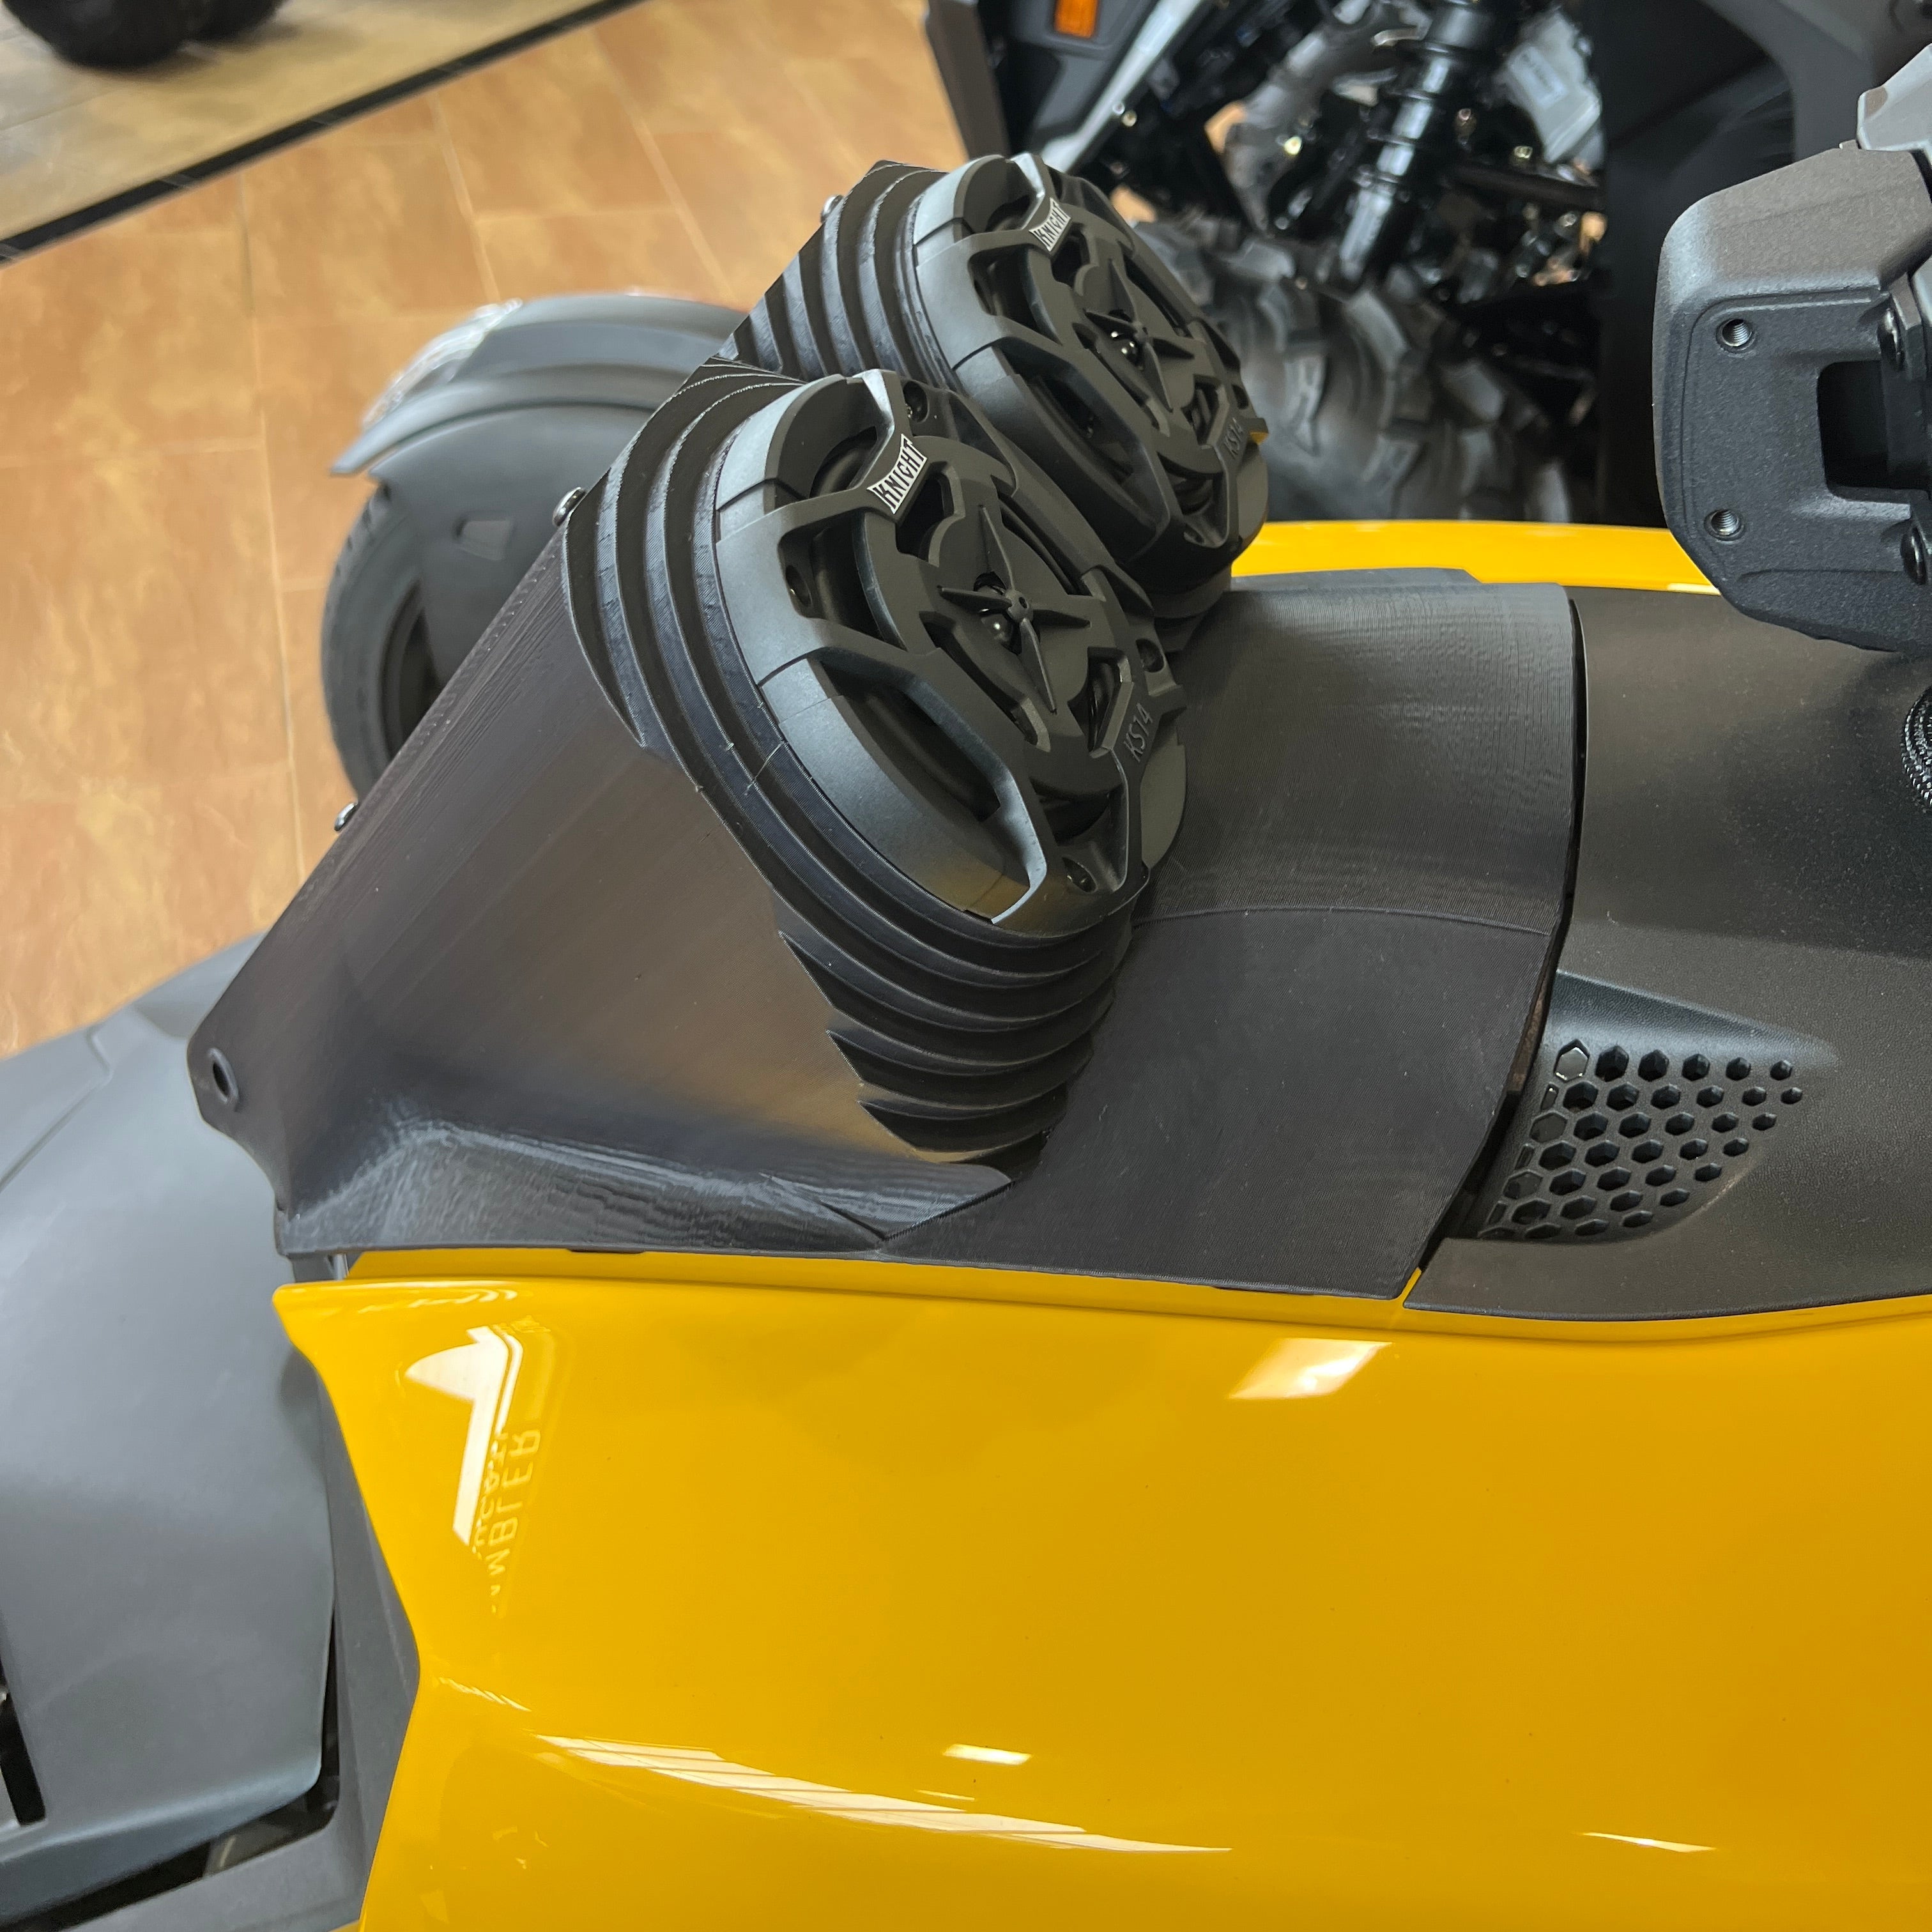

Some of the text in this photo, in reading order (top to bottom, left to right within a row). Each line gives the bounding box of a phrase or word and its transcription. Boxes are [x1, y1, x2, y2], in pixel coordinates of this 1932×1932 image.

[1033, 201, 1068, 247] KNIGHT
[873, 438, 924, 509] KNIGHT
[1123, 703, 1153, 762] KS14
